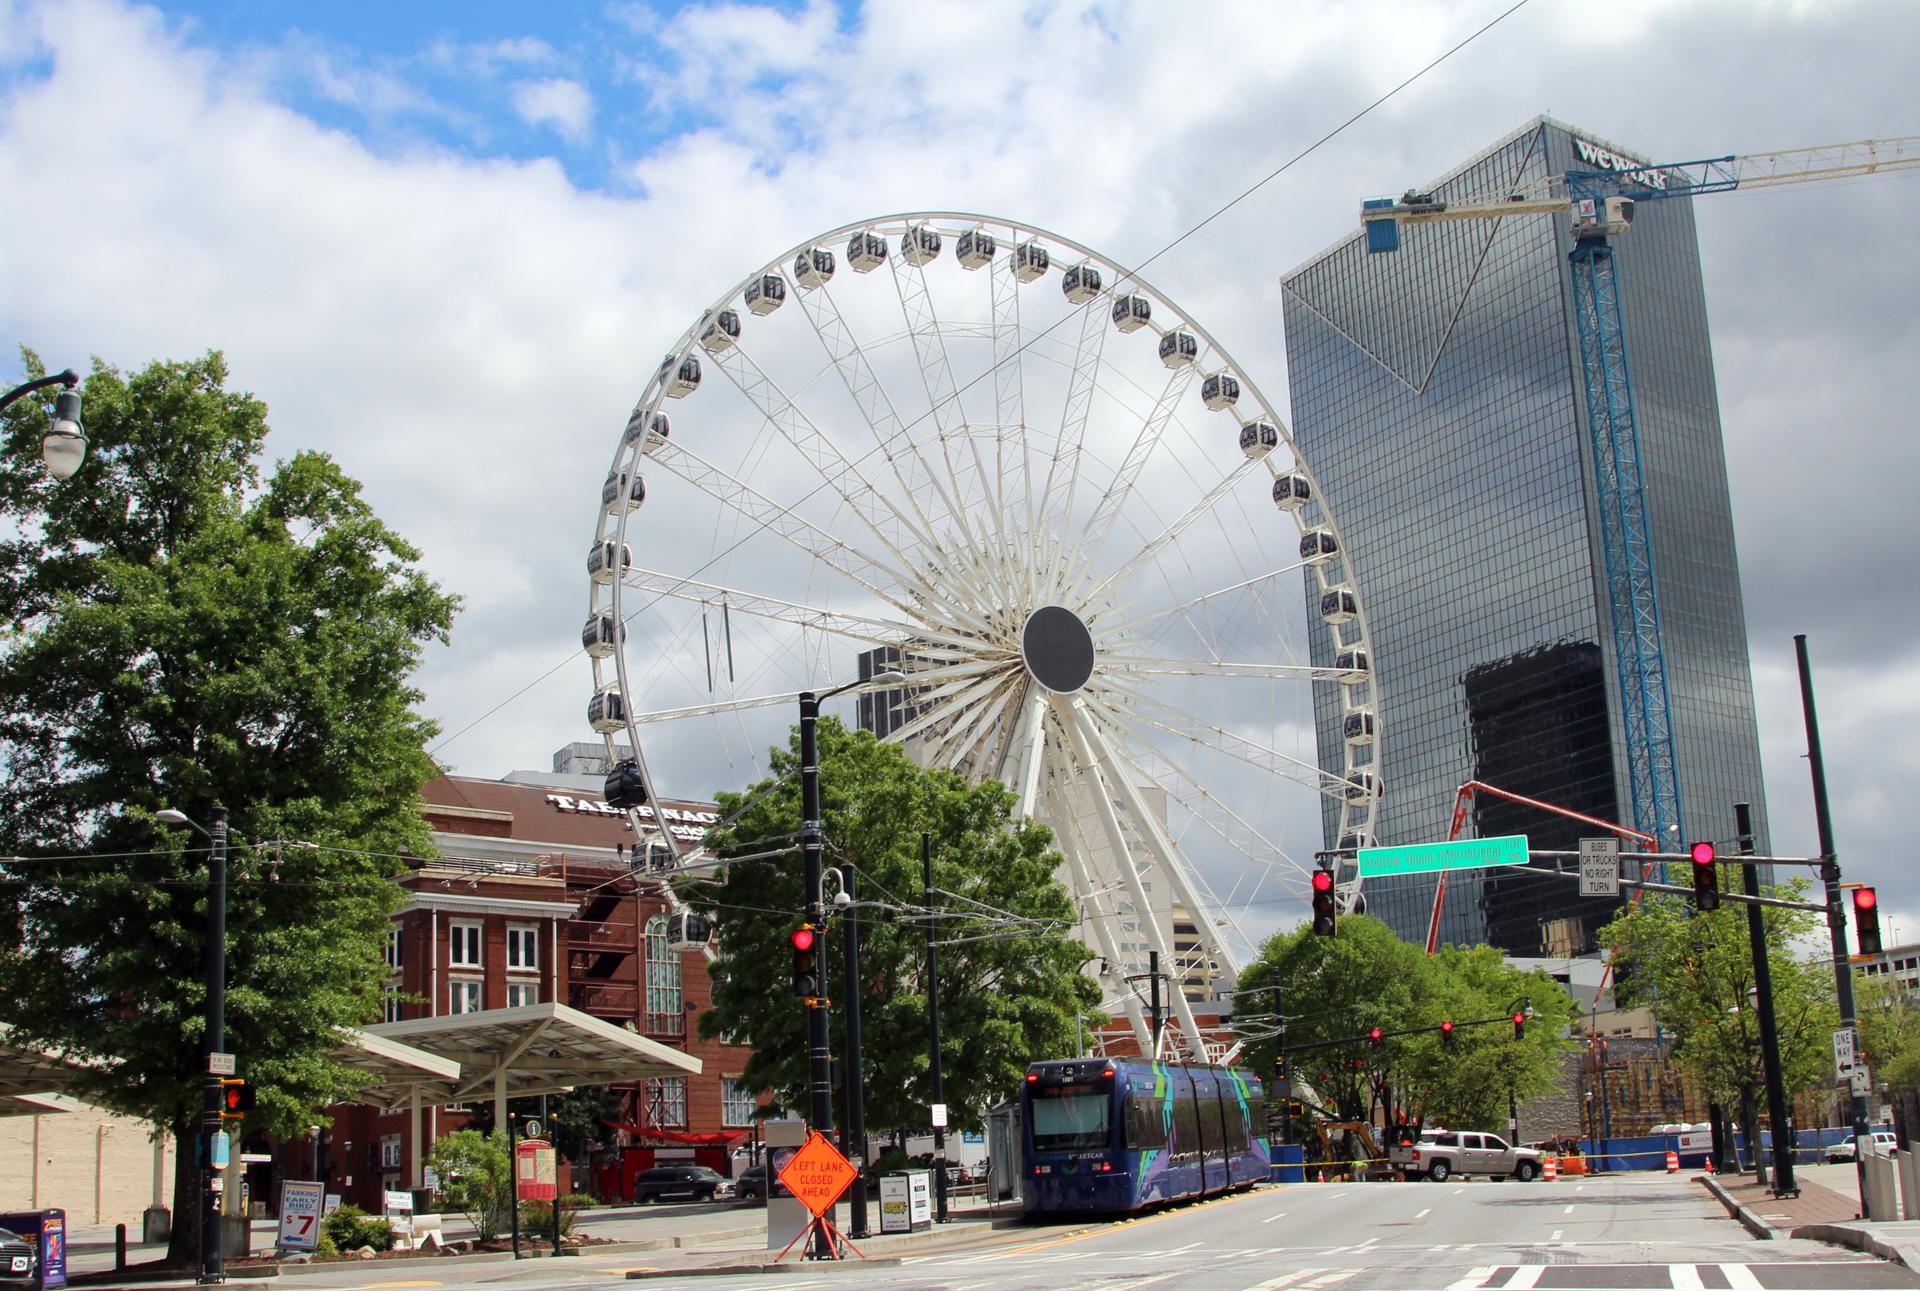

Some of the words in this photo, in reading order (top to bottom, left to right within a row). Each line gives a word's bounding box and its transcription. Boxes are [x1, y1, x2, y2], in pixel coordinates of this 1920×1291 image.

[1591, 842, 1607, 852] BUSES
[1365, 854, 1400, 869] Andrew
[1406, 851, 1434, 866] Young
[1439, 847, 1500, 861] International
[1583, 855, 1591, 865] OR
[1592, 855, 1616, 865] TRUCKS
[1585, 869, 1594, 878] NO
[1595, 869, 1613, 878] RIGHT
[1589, 881, 1609, 892] TURN
[1836, 1033, 1850, 1045] ONE
[1837, 1046, 1850, 1057] WAY
[793, 1161, 816, 1171] LEFT
[821, 1161, 844, 1173] LANE
[800, 1175, 833, 1185] CLOSED
[803, 1187, 830, 1197] AHEAD
[285, 1196, 317, 1204] EARLY
